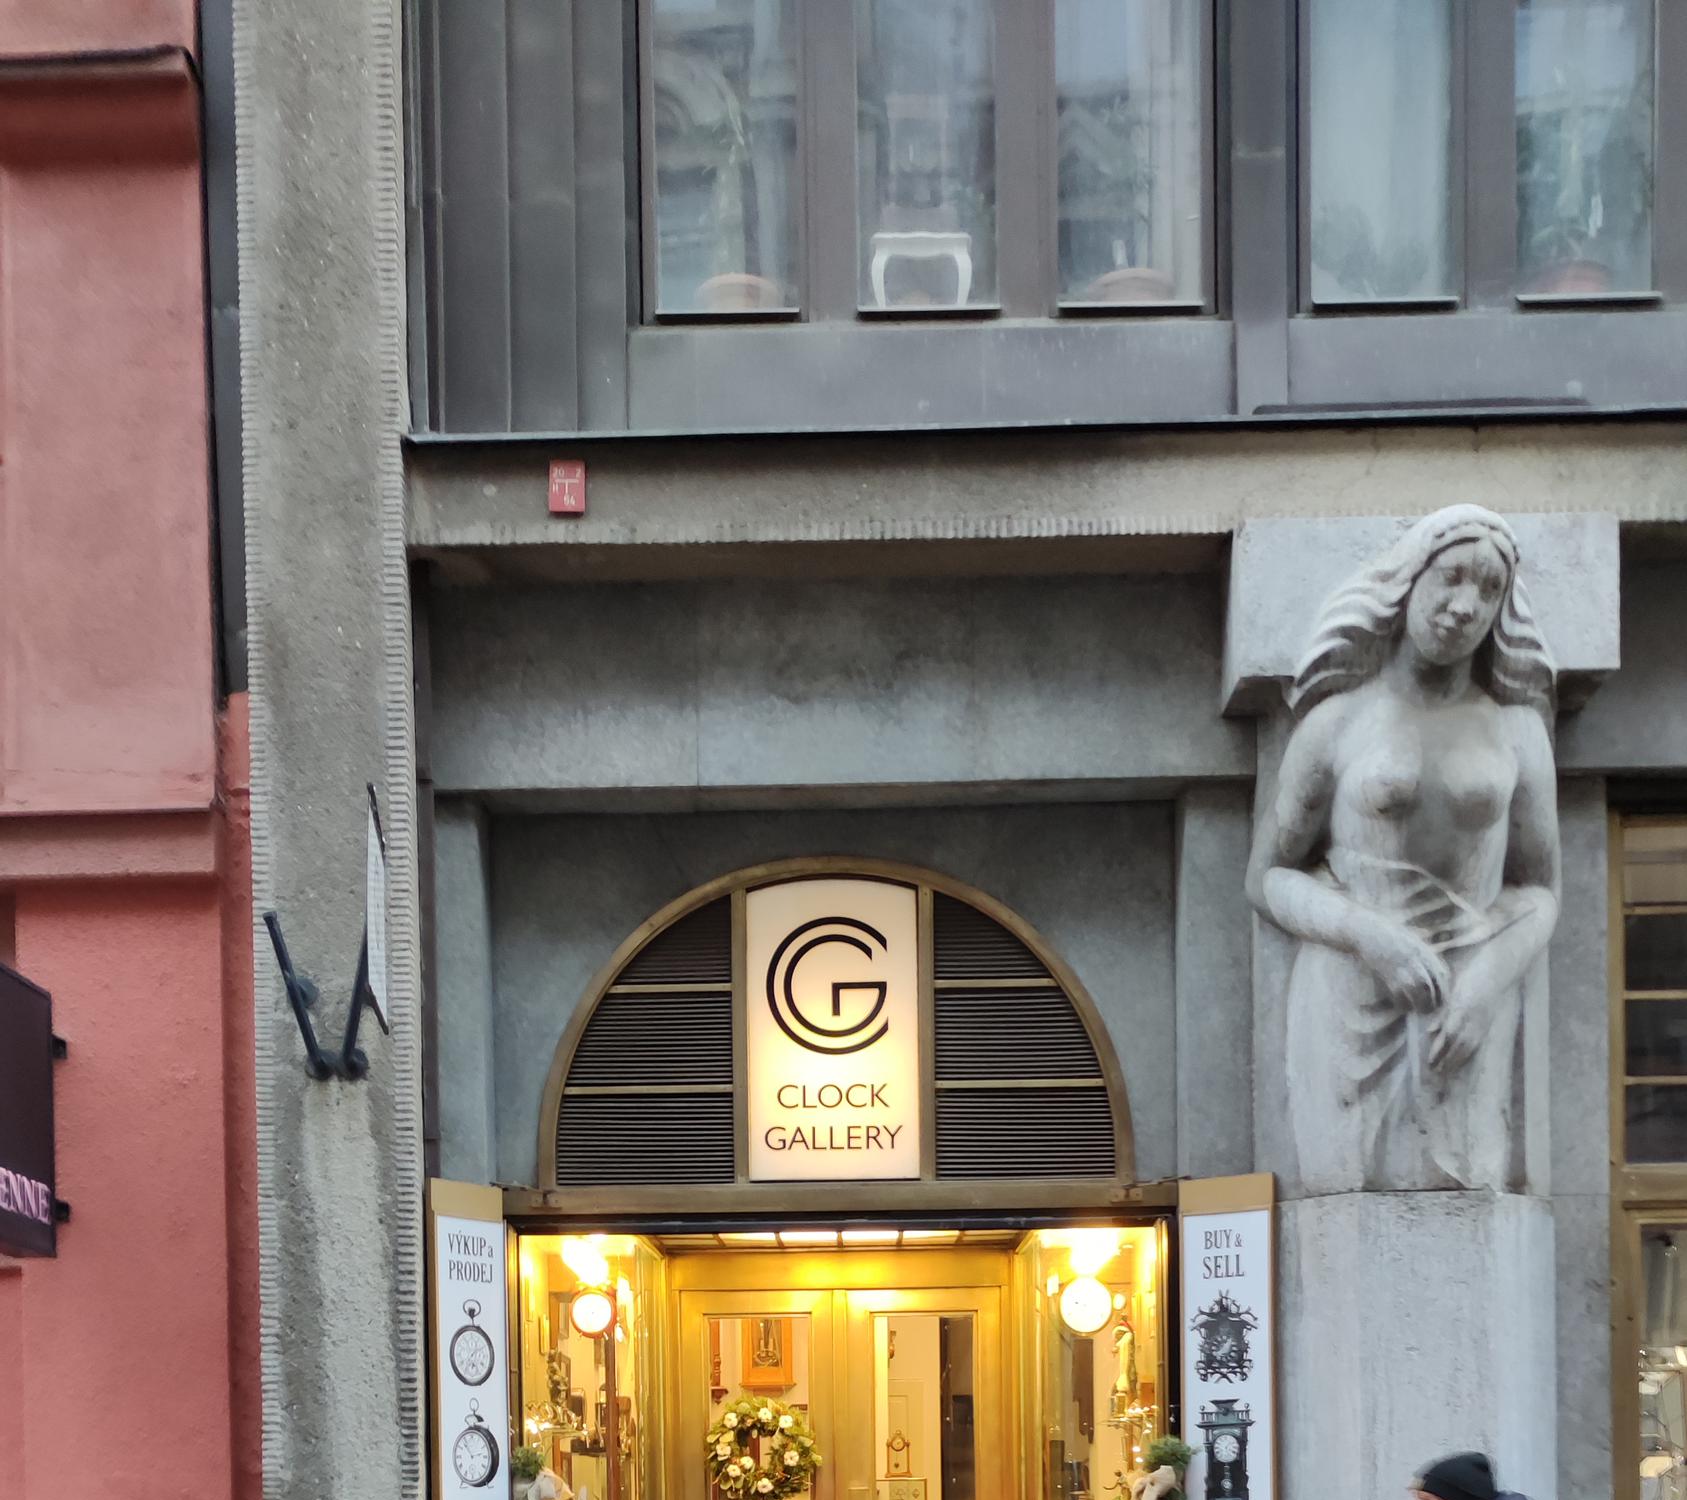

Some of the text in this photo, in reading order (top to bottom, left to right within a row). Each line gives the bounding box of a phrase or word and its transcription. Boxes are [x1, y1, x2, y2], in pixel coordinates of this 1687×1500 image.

[777, 1083, 890, 1109] CLOCK
[765, 1125, 903, 1151] GALLERY
[448, 1229, 494, 1258] VÝKUP a
[1204, 1229, 1243, 1250] BUY &
[449, 1260, 493, 1284] PRODEJ
[1203, 1254, 1245, 1280] SELL
